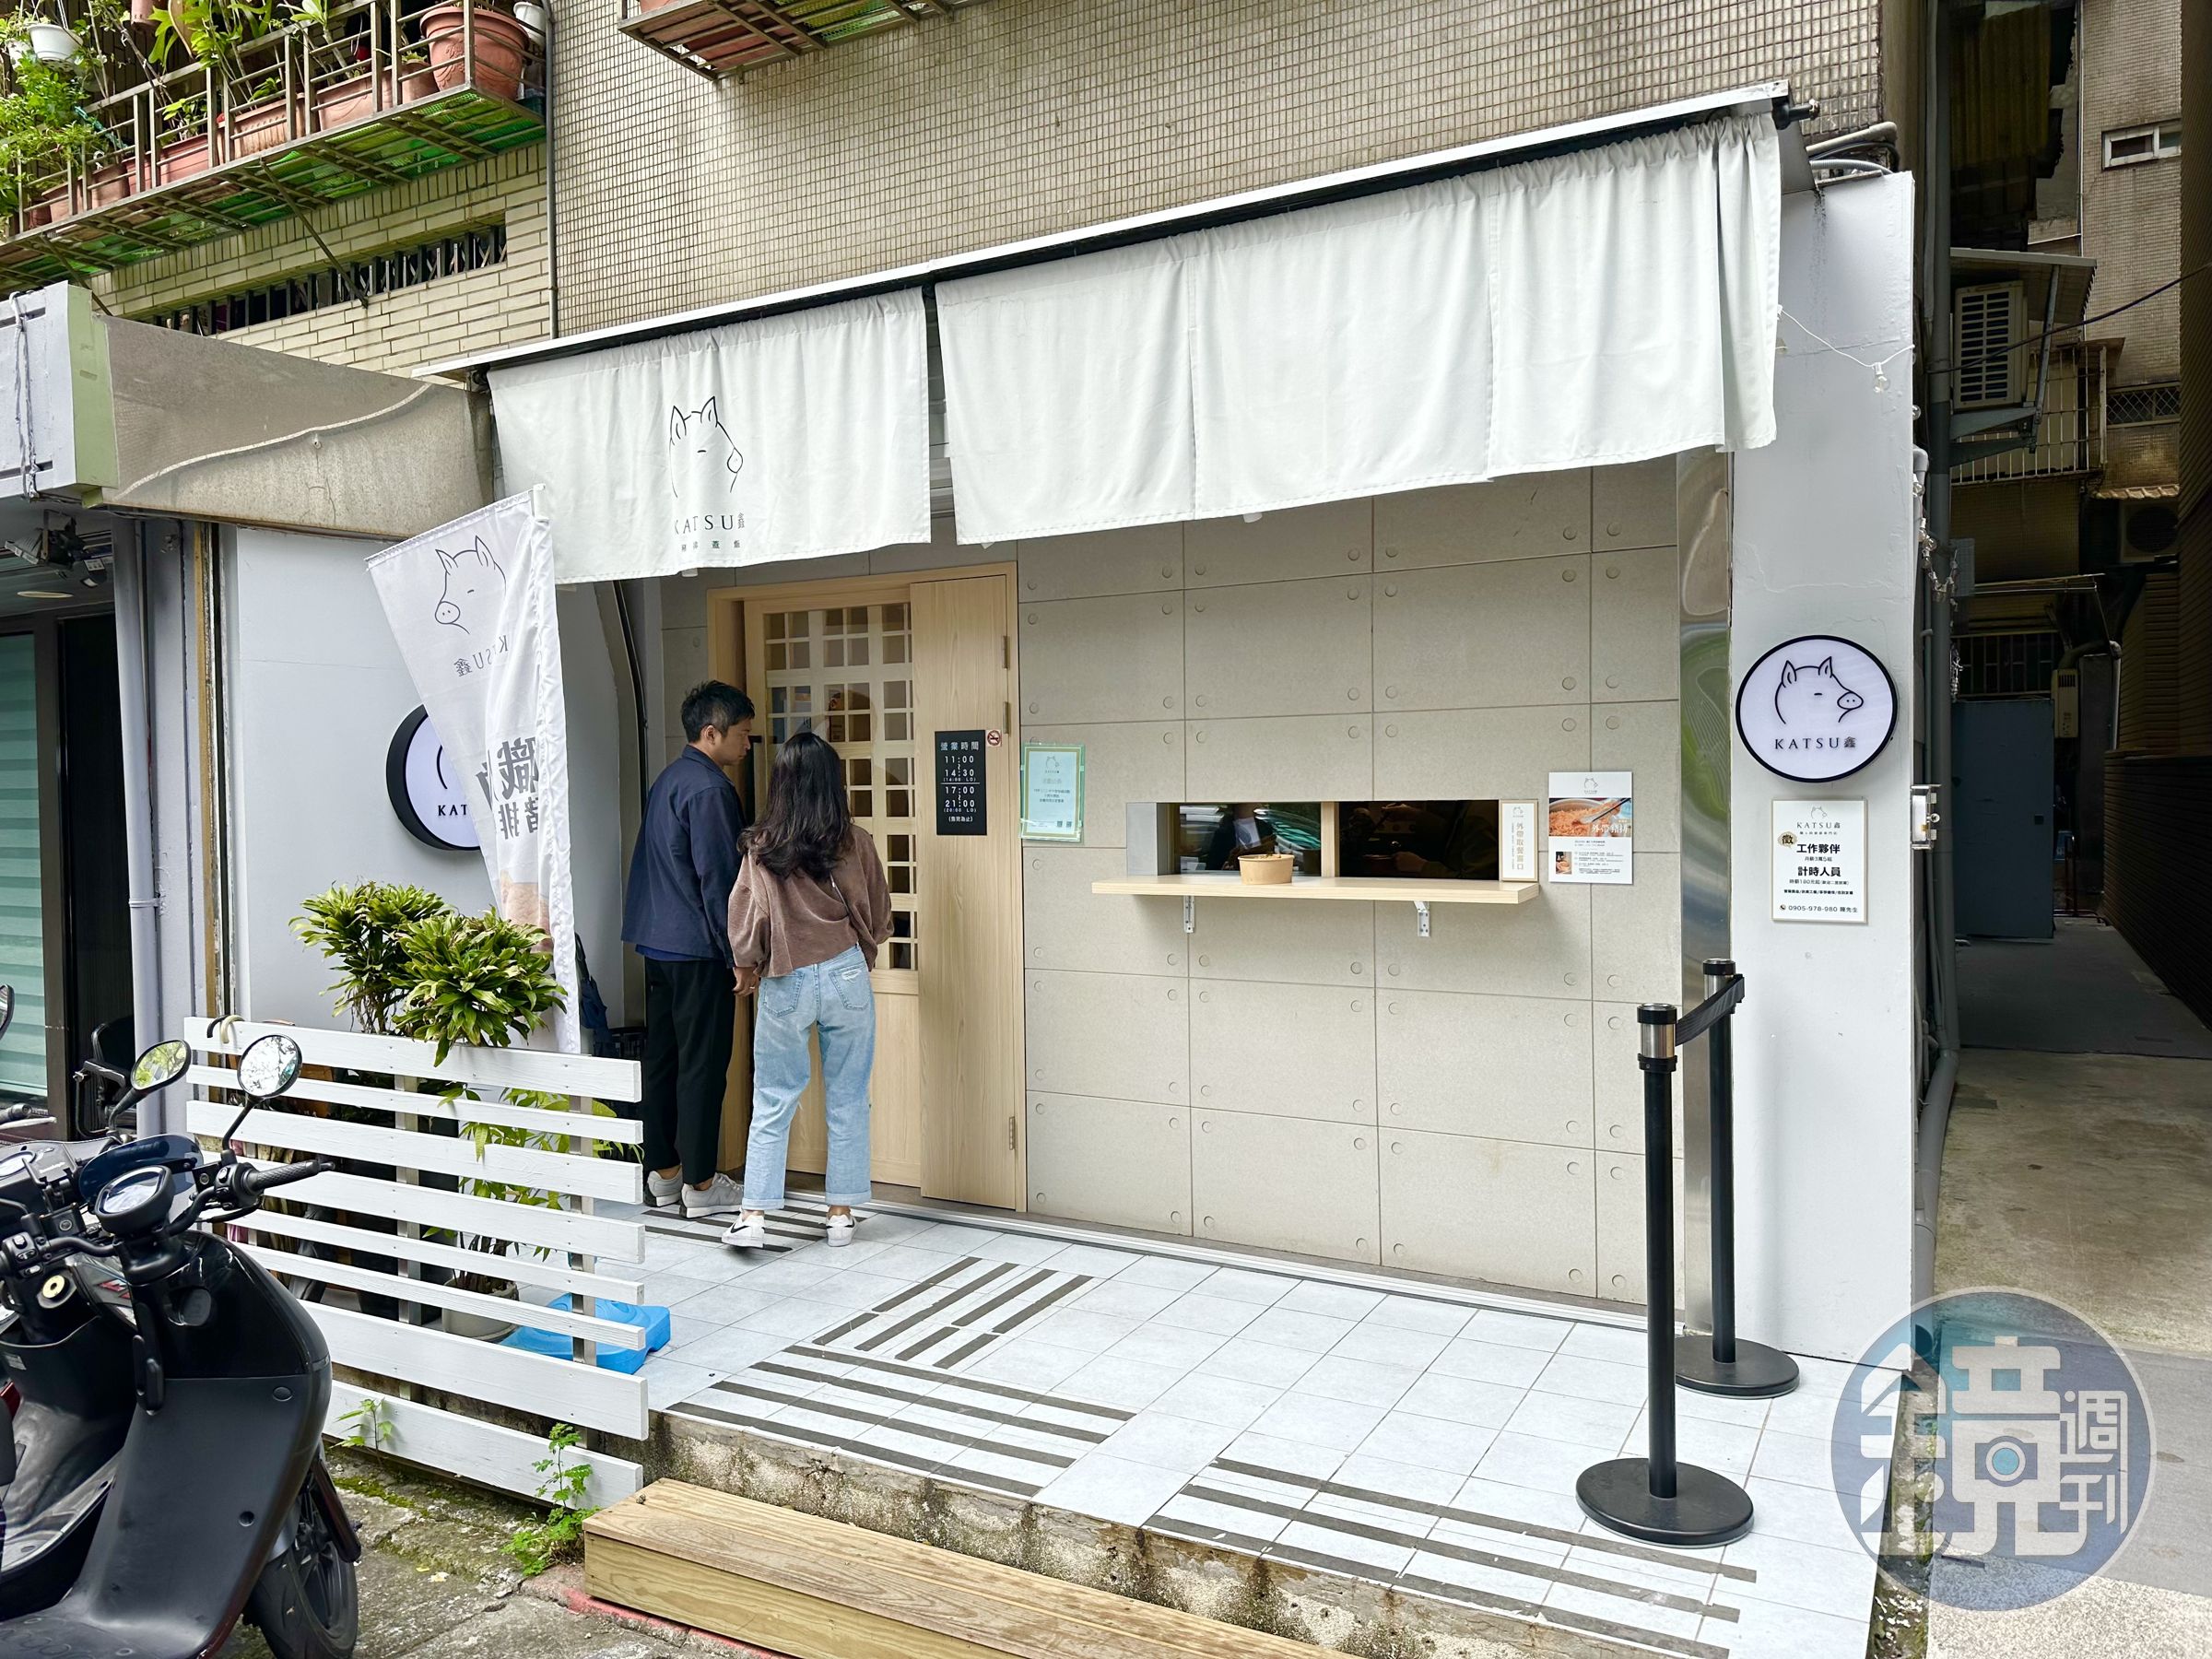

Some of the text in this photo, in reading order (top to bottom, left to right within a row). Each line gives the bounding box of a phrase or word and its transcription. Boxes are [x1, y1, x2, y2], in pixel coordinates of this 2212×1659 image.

[940, 741, 979, 751] 營業時間
[1775, 736, 1856, 749] KATSU鑫
[945, 755, 974, 763] 11:00
[945, 769, 974, 777] 14:30
[945, 786, 975, 794] 17:00
[945, 799, 975, 807] 21:00
[1796, 843, 1841, 854] 工作夥伴
[1797, 866, 1841, 877] 計時人員
